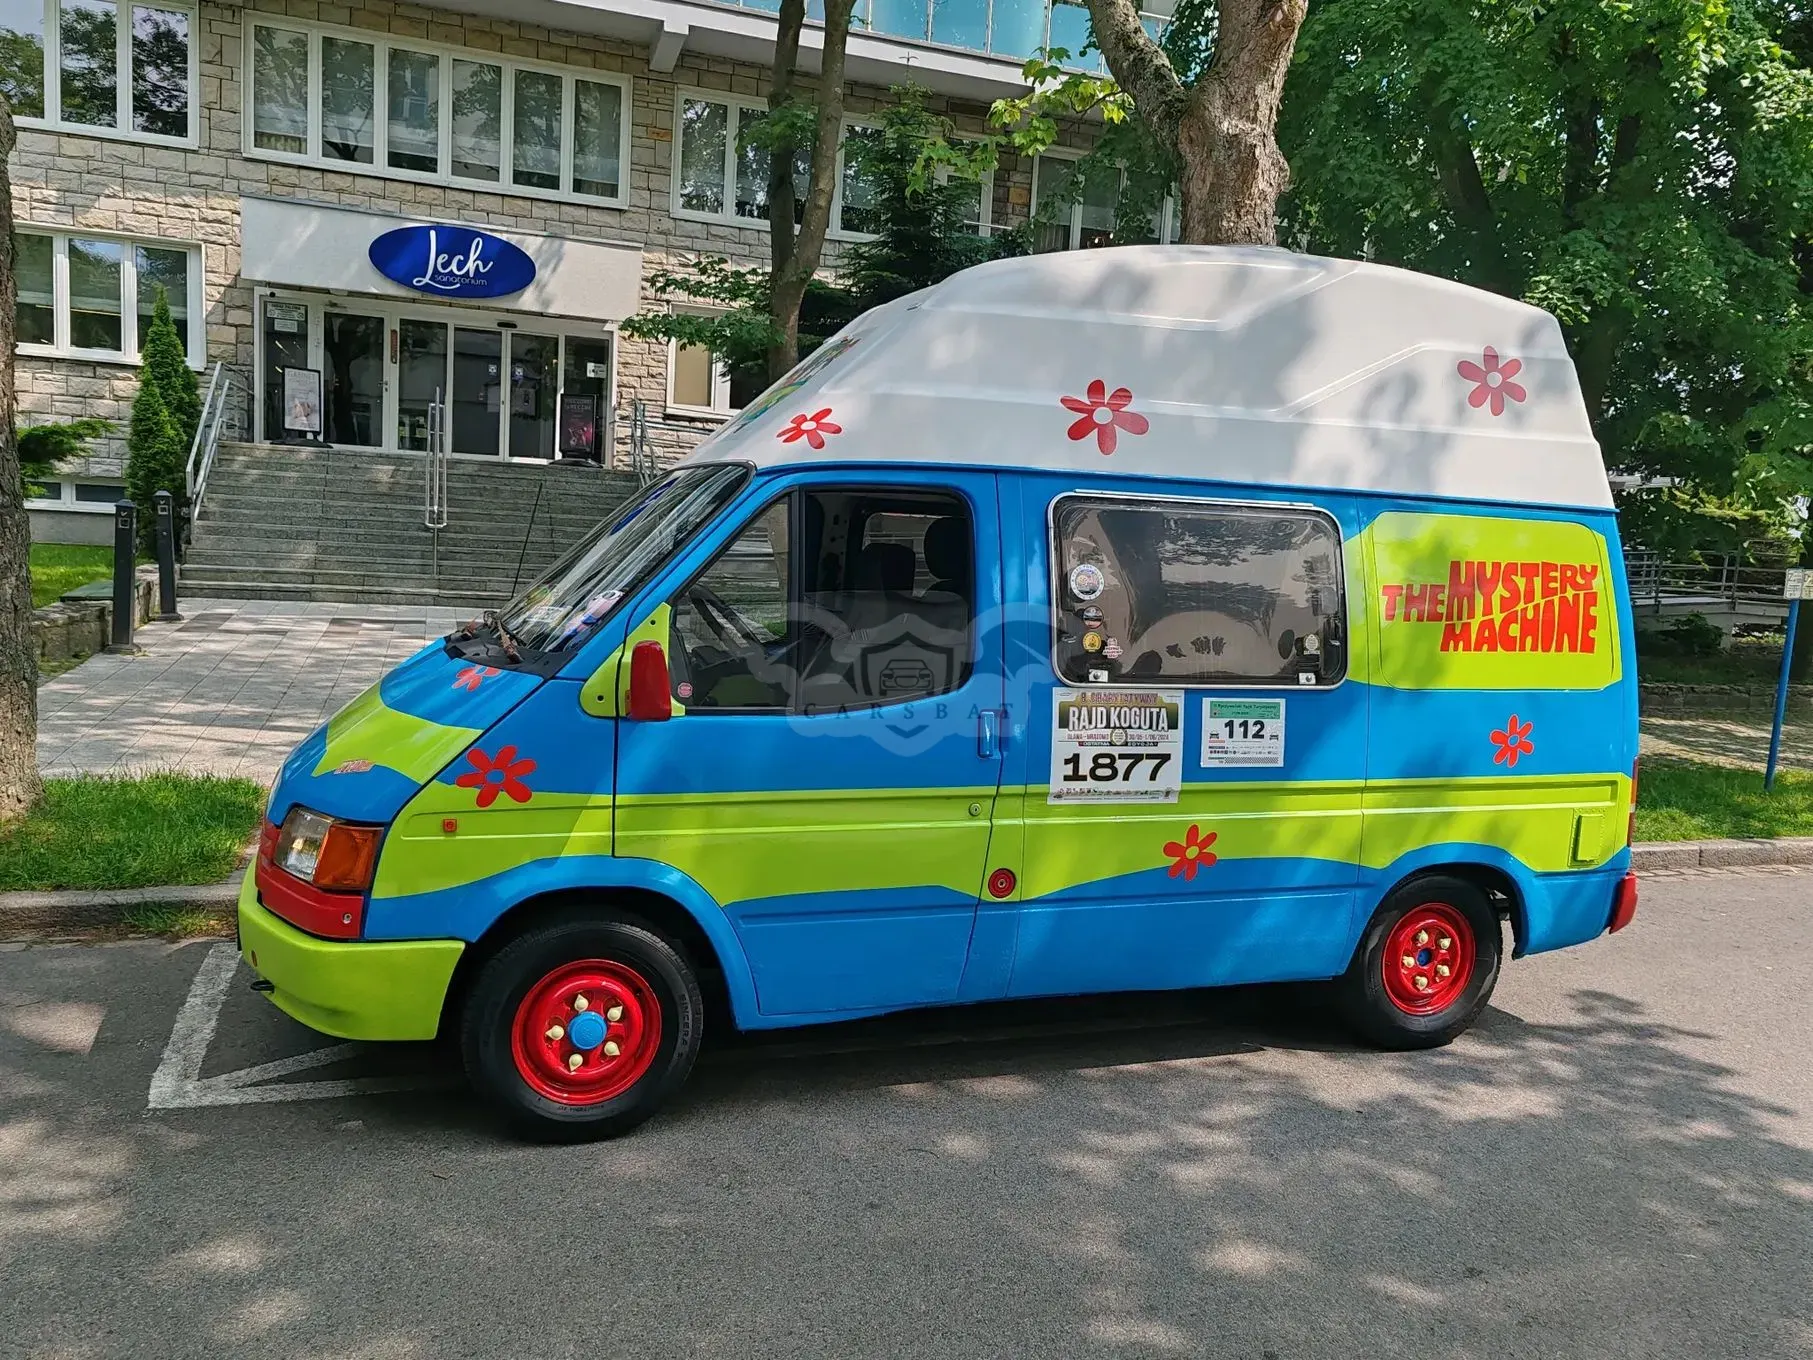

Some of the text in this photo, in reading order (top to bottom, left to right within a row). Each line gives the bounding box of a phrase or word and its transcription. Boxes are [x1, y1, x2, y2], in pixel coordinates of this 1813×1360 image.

[413, 230, 494, 290] Lech
[434, 274, 488, 286] sanatorium
[1382, 560, 1599, 622] THE MYSTERY
[1440, 591, 1599, 653] MACHINE
[1068, 706, 1169, 732] RAJD KOGUTA
[1224, 719, 1265, 739] 112
[1063, 753, 1171, 782] 1877
